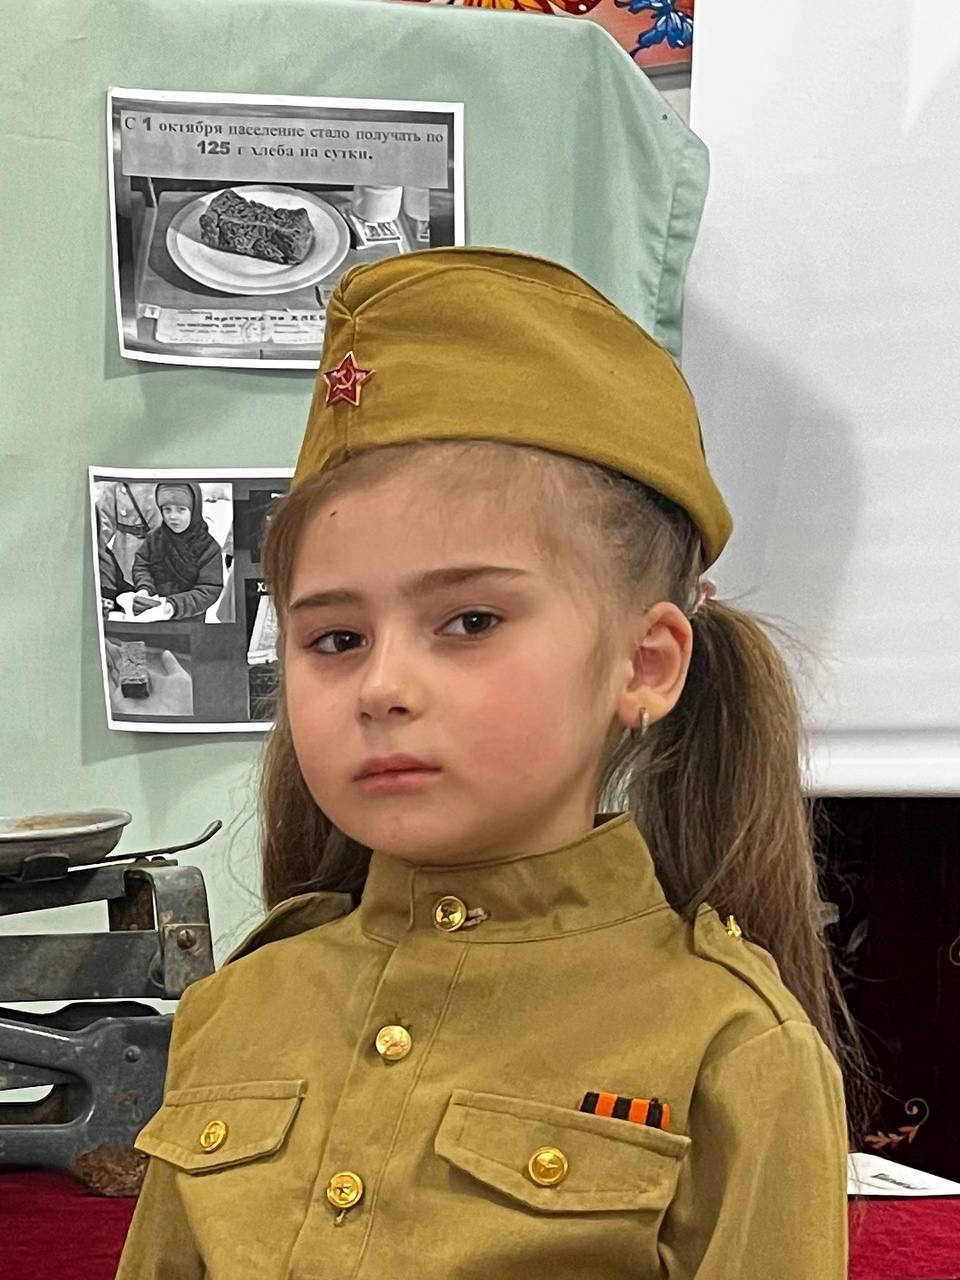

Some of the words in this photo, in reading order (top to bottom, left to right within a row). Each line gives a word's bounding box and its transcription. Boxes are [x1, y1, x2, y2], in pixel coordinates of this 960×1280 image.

[124, 116, 136, 130] С
[142, 117, 152, 131] 1
[159, 121, 223, 136] октября
[228, 125, 304, 137] население
[310, 128, 350, 139] стало
[356, 130, 421, 144] получать
[426, 132, 444, 143] по
[197, 140, 230, 155] 125
[251, 144, 294, 157] хлеба
[300, 148, 318, 157] на
[324, 149, 373, 162] сутки.
